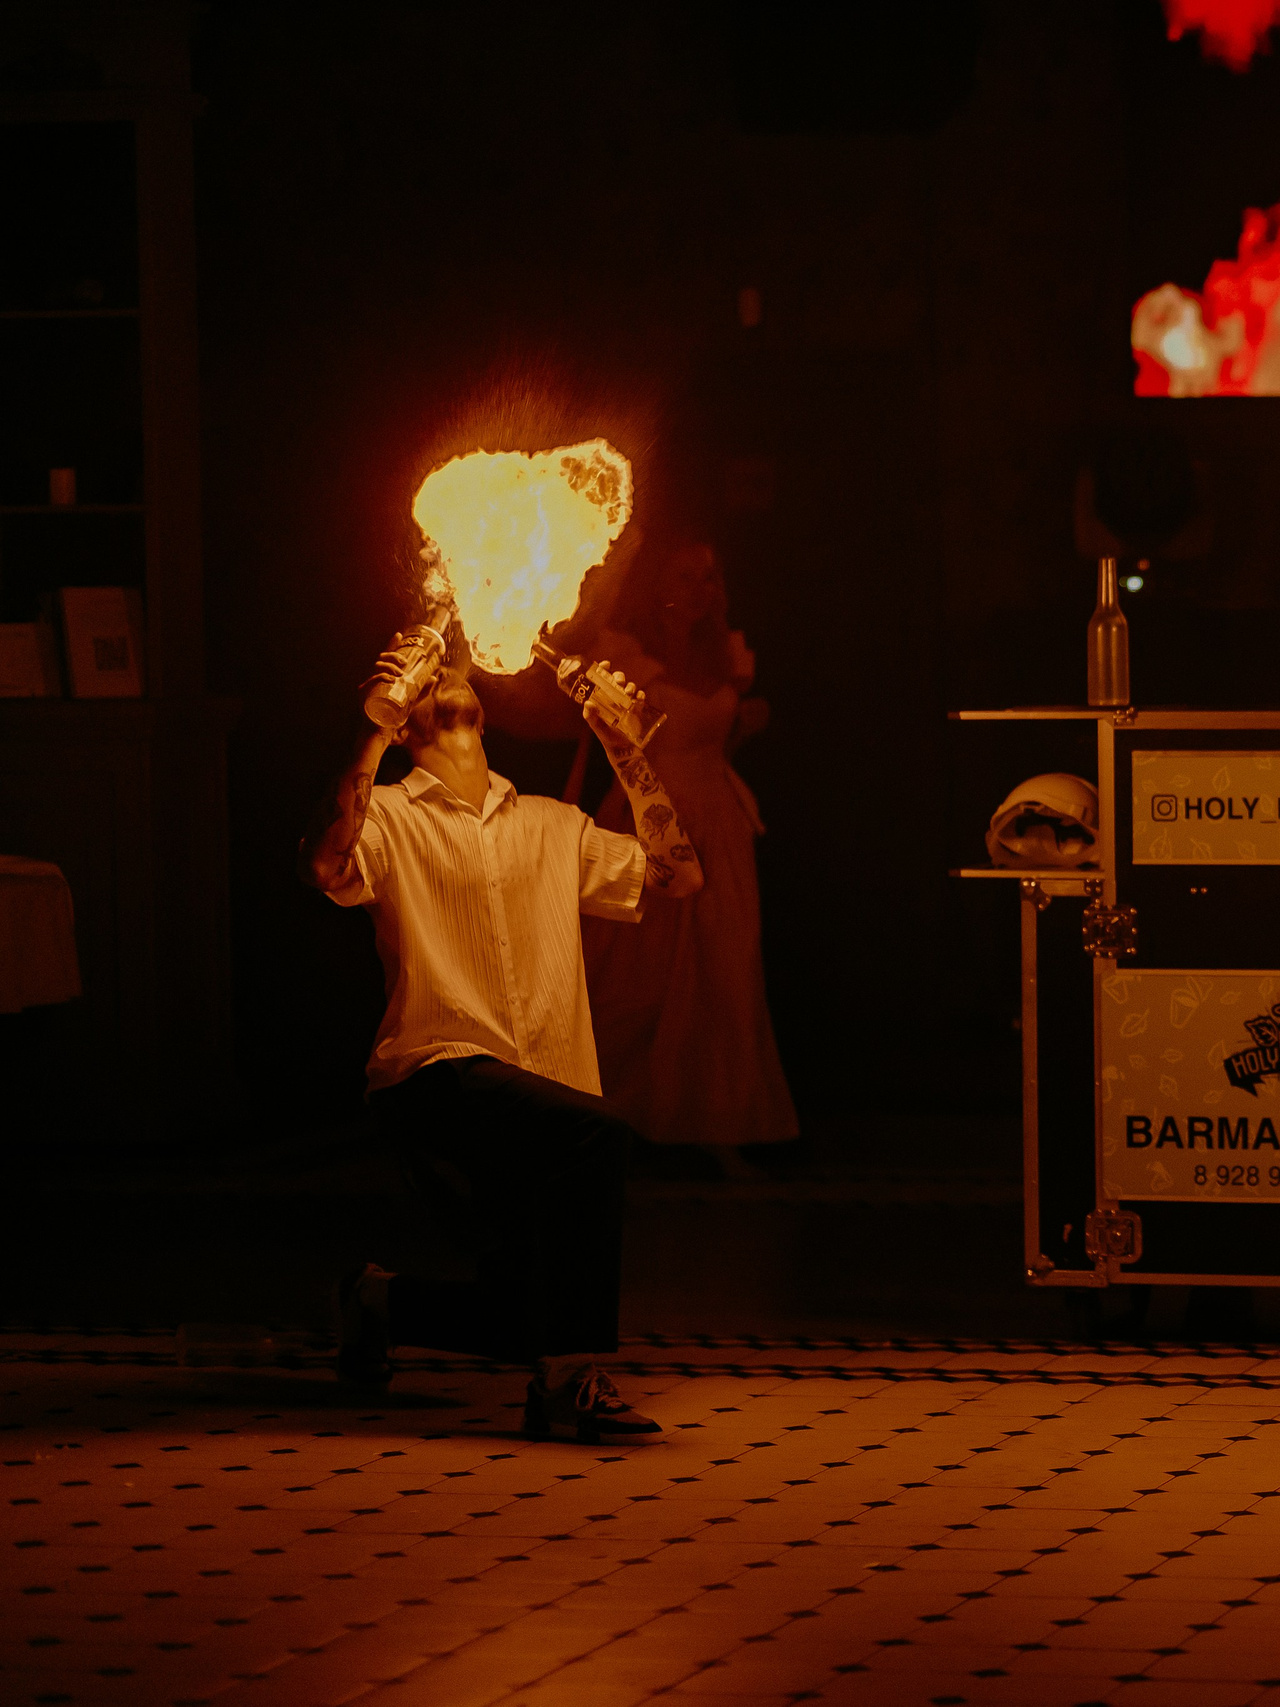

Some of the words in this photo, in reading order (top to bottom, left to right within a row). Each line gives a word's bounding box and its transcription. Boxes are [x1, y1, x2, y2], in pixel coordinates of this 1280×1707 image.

[1231, 1048, 1279, 1079] HOLY
[1193, 1165, 1207, 1186] 8
[1215, 1165, 1260, 1187] 928
